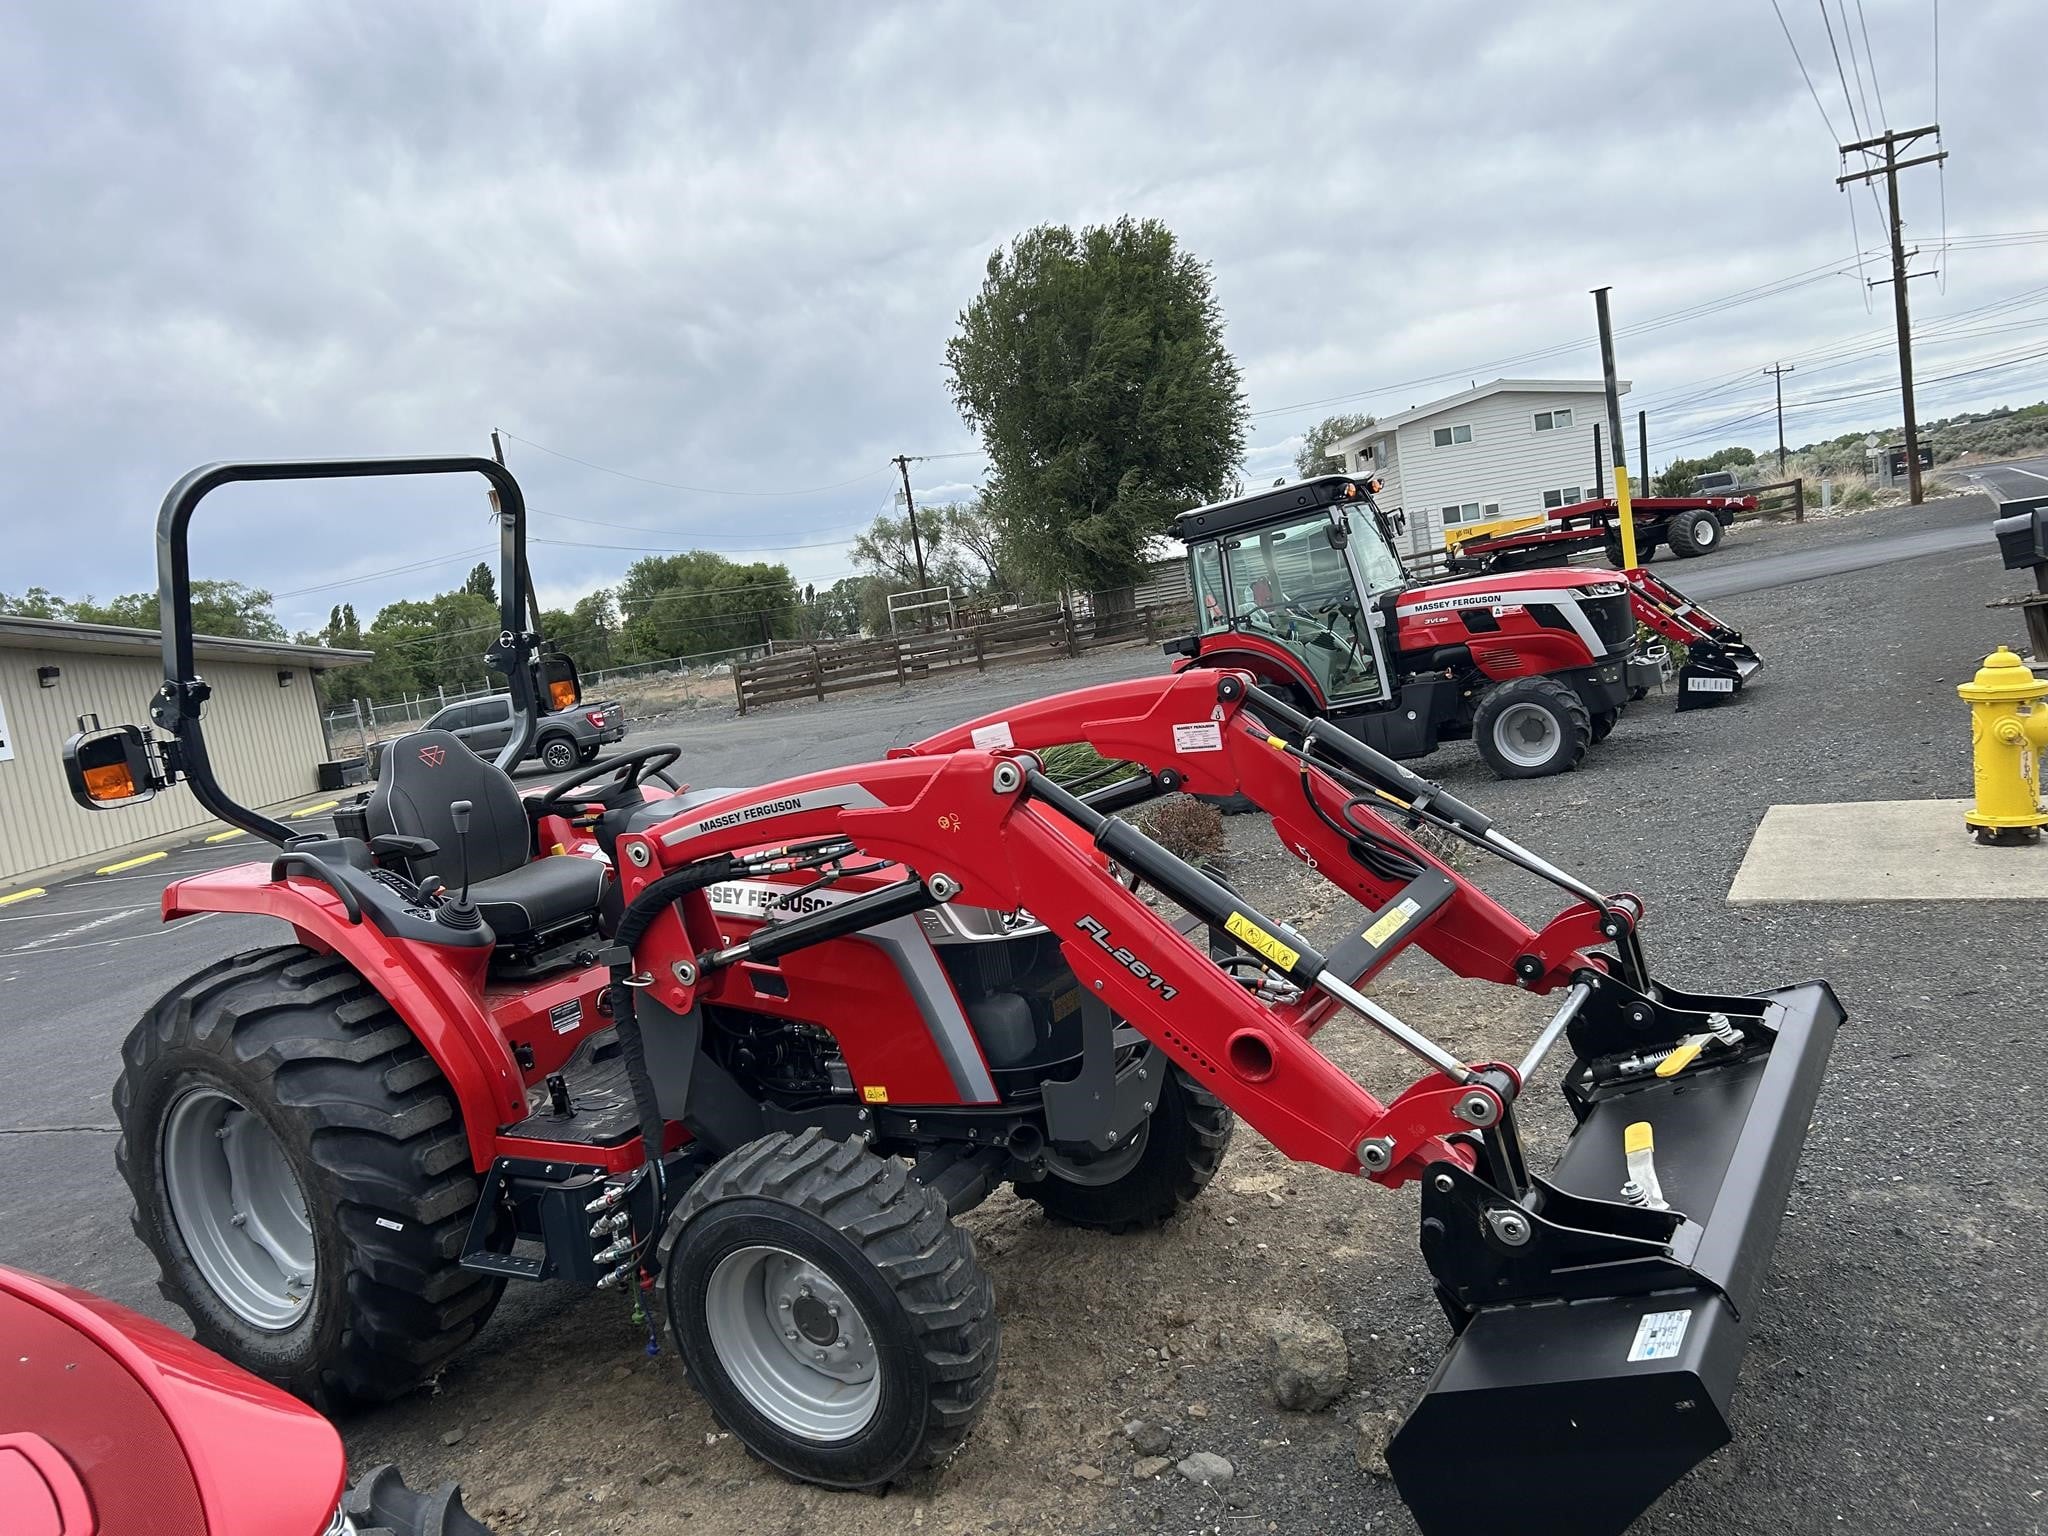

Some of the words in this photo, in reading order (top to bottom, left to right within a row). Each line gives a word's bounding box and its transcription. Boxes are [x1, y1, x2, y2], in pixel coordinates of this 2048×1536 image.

[1414, 600, 1450, 613] MASSEY
[1452, 594, 1501, 606] FERGUSON
[699, 811, 741, 833] MASSEY
[744, 798, 802, 820] FERGUSON
[705, 886, 744, 905] SSEY
[747, 889, 840, 914] FERGUSO
